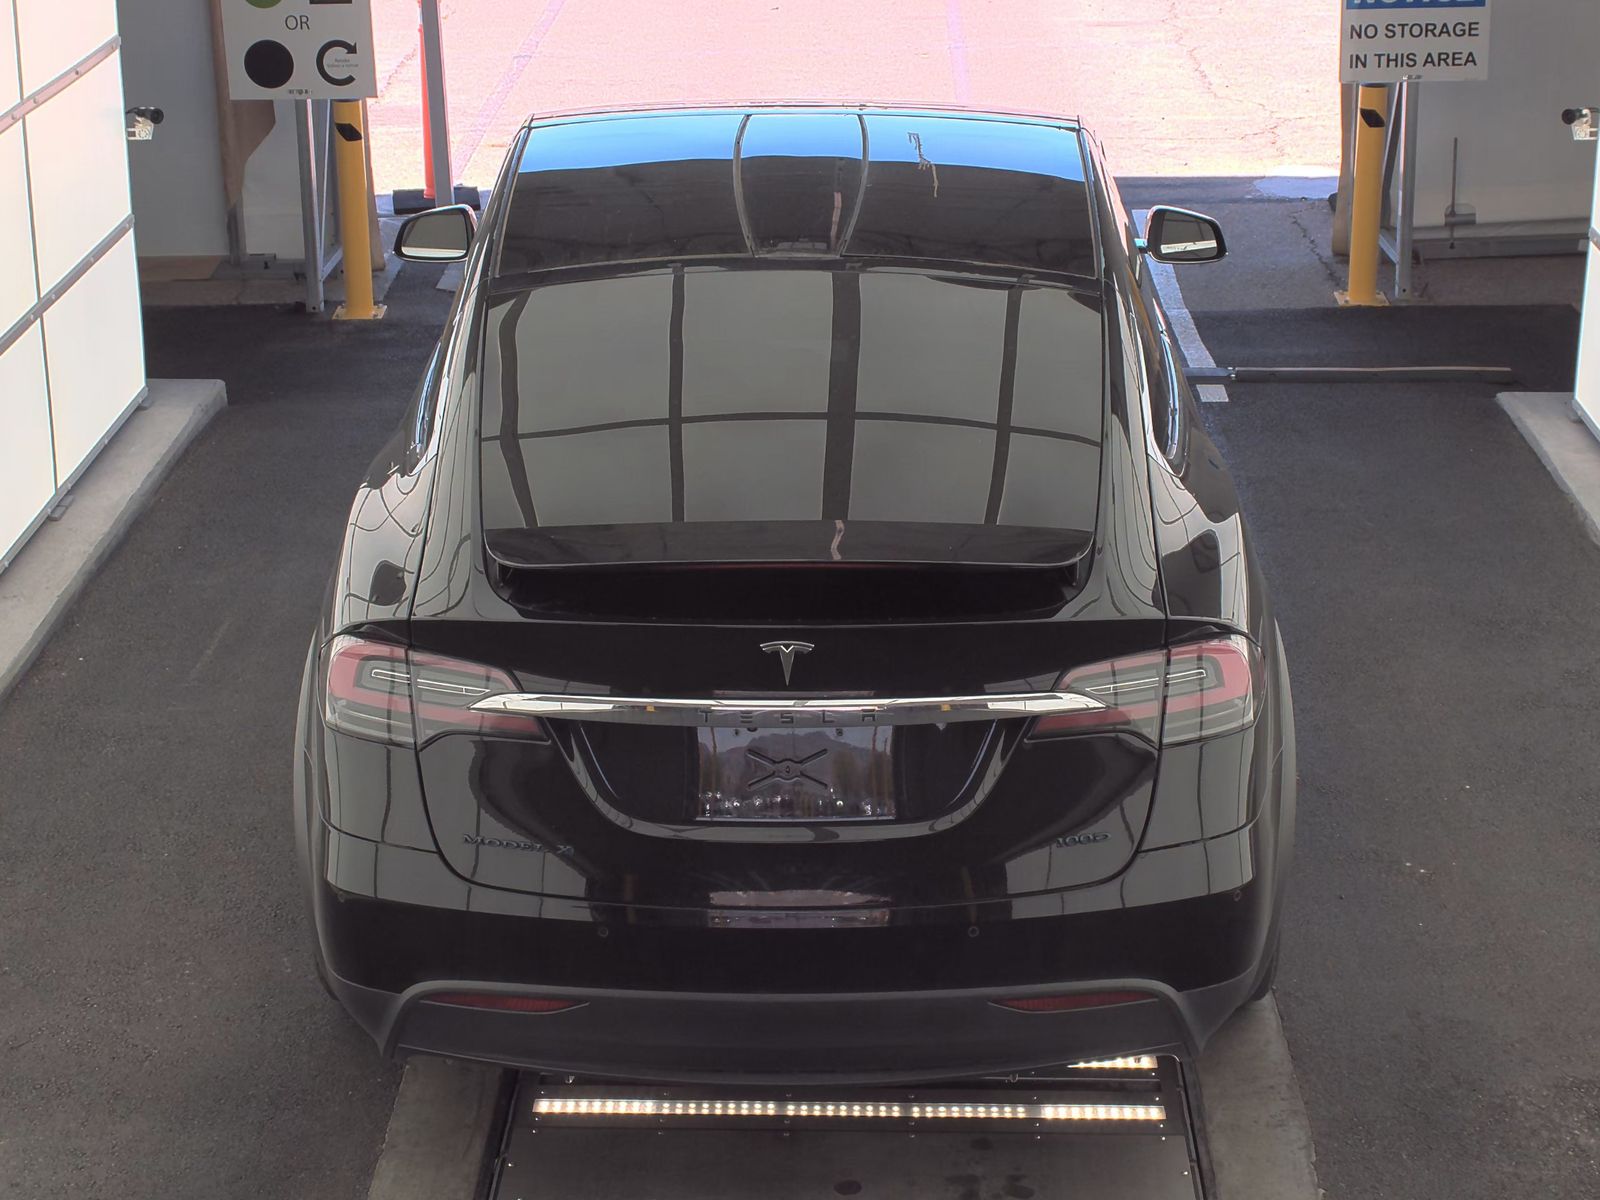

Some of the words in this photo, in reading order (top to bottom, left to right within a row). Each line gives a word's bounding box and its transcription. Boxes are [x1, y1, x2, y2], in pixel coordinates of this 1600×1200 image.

[285, 15, 310, 30] OR
[1350, 24, 1378, 39] NO
[1384, 22, 1480, 39] STORAGE
[1349, 54, 1367, 69] IN
[1374, 52, 1417, 69] THIS
[1422, 51, 1477, 67] AREA
[698, 708, 877, 723] TESLA
